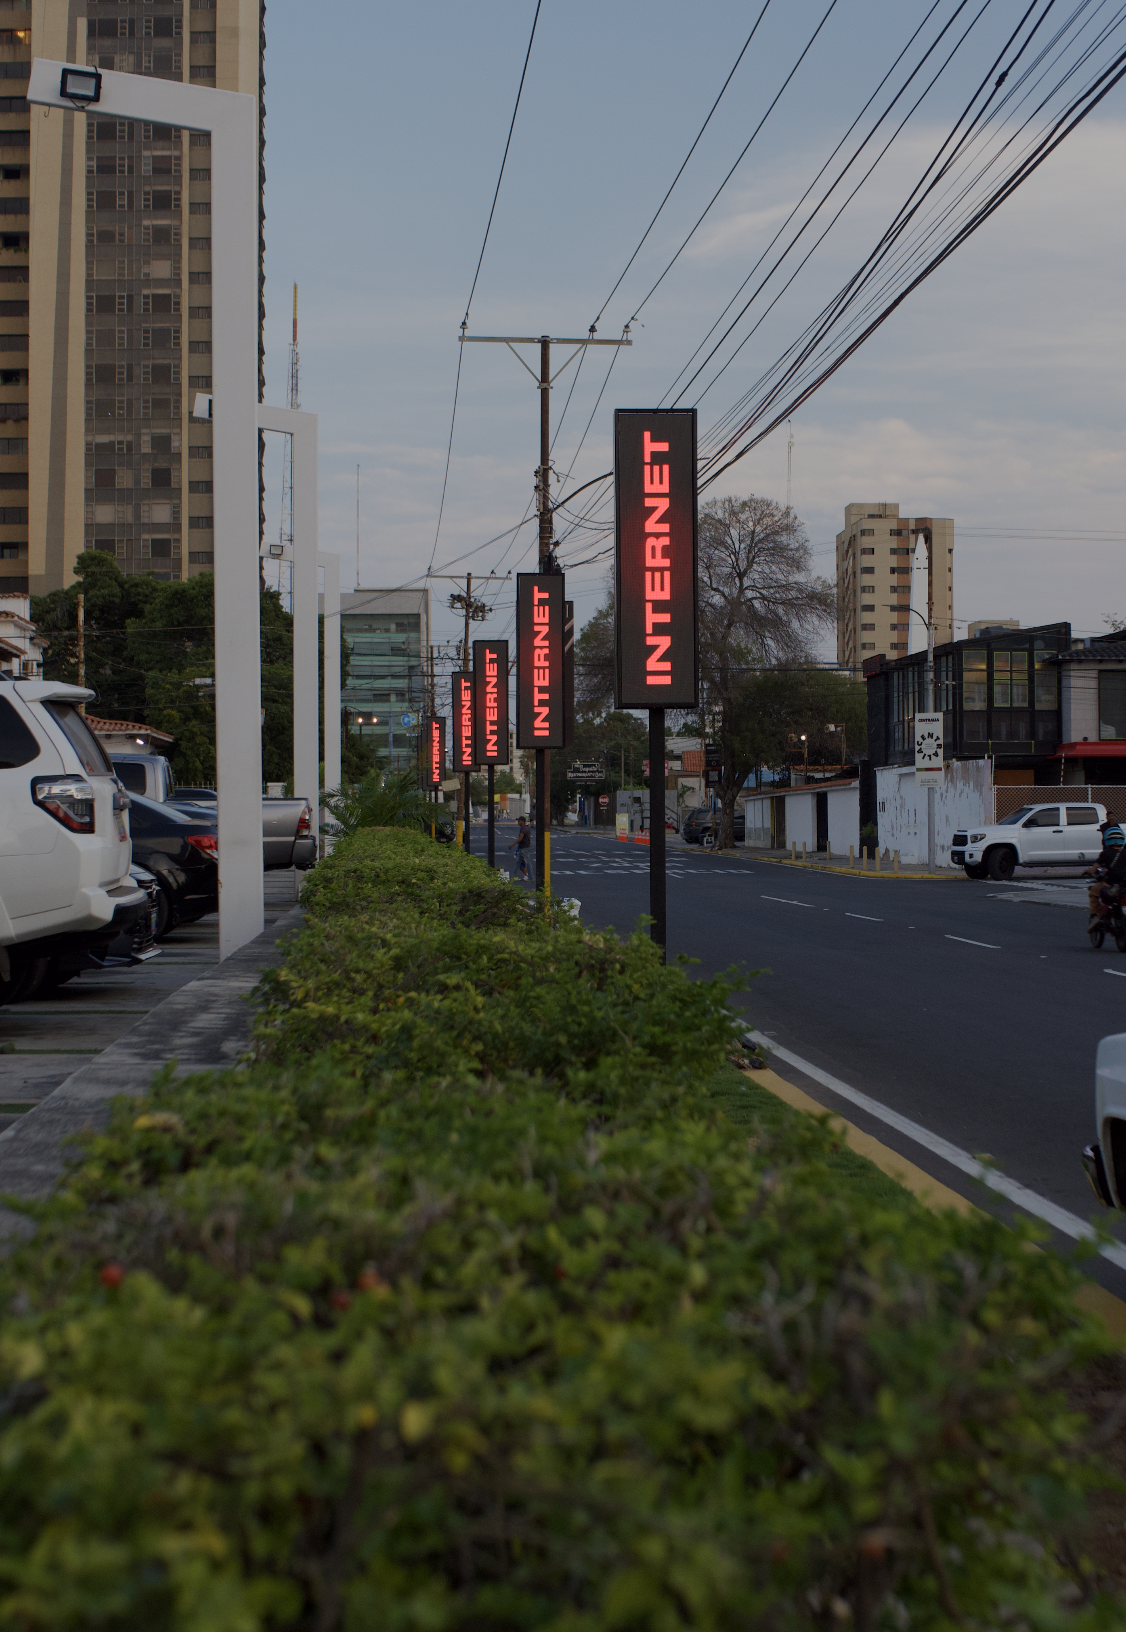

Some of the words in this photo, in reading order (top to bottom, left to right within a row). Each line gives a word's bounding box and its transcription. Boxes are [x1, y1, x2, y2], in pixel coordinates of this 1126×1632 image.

[643, 430, 672, 685] INTERNET
[485, 648, 498, 757] INTERNET
[532, 585, 550, 737] INTERNET
[432, 720, 440, 782] INTERNET
[461, 678, 472, 766] INTERNET
[916, 731, 943, 761] CENTRALIA
